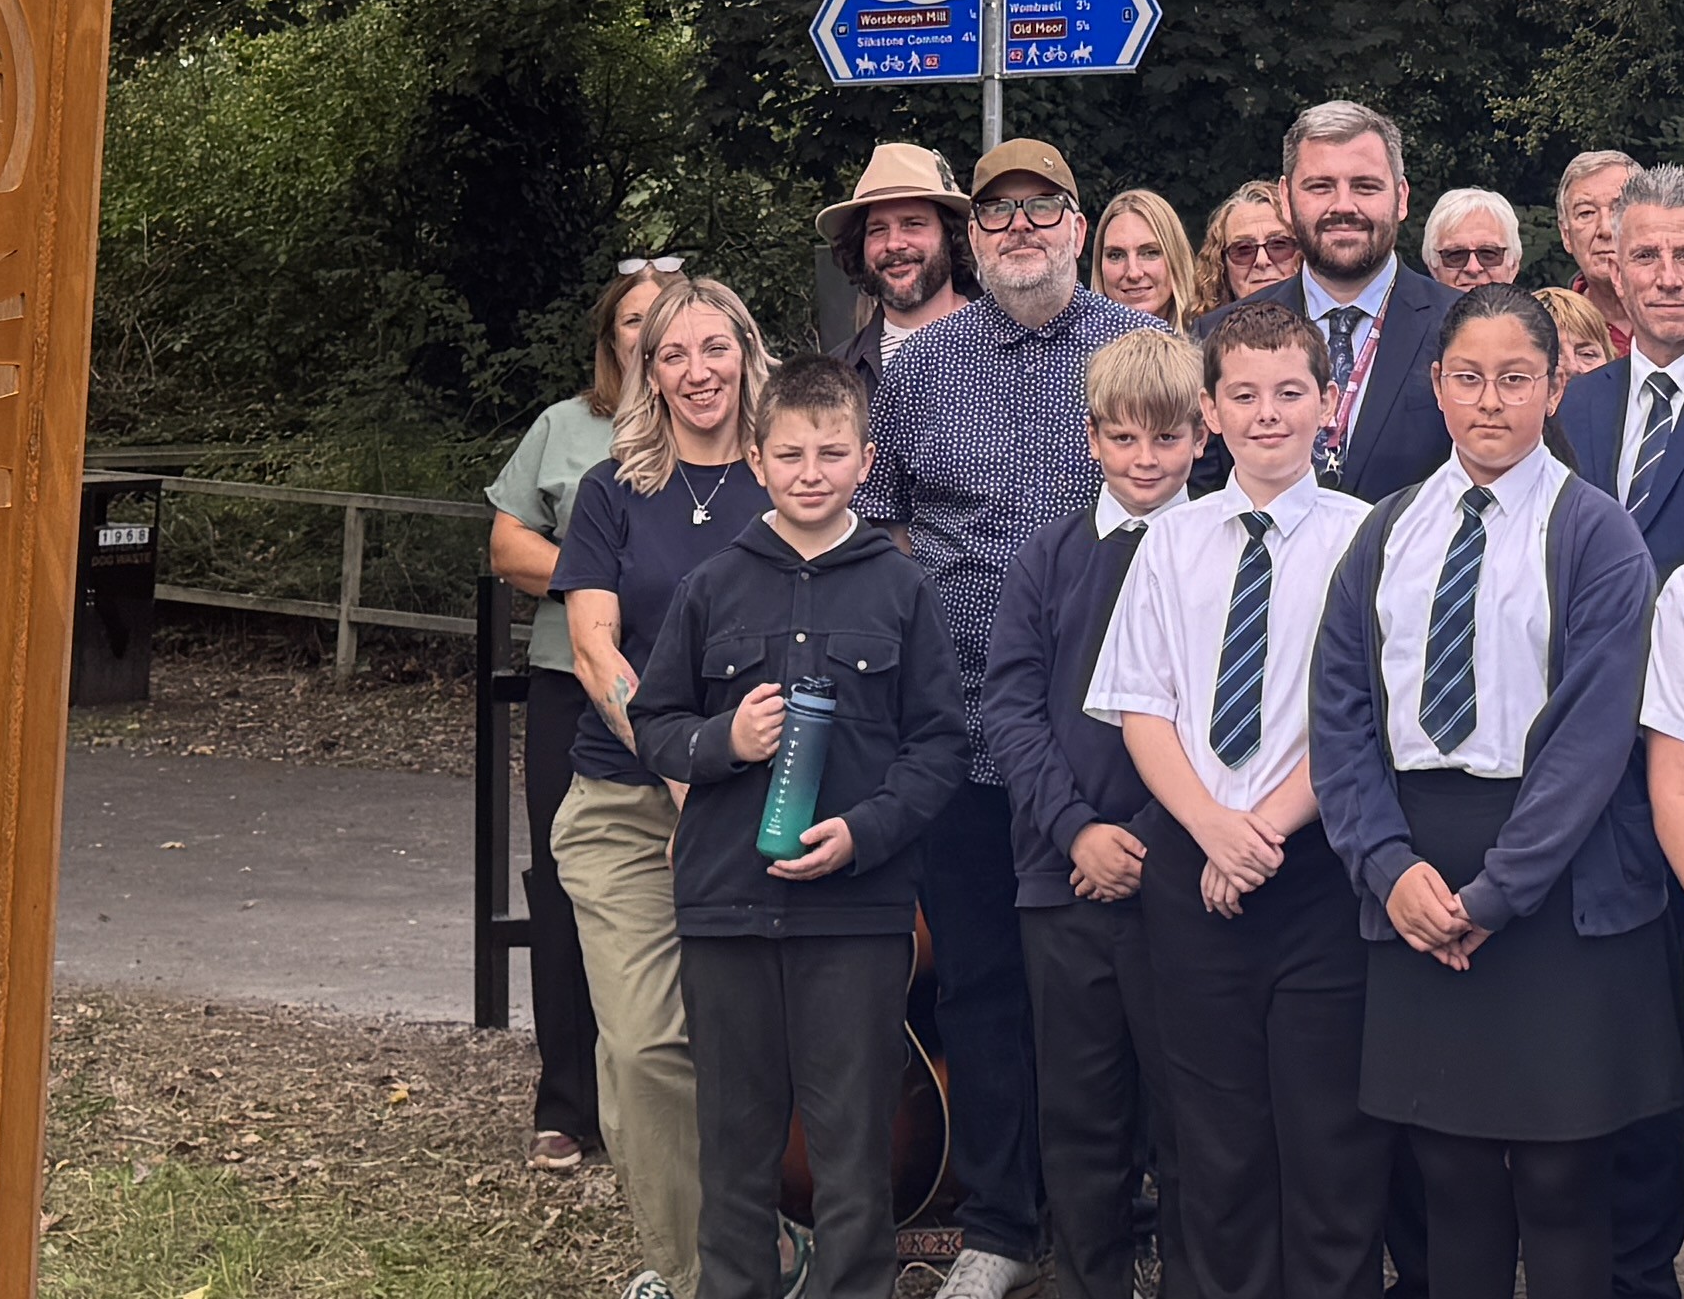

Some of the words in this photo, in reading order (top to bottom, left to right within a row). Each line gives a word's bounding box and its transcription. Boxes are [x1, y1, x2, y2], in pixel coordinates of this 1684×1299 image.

[1009, 1, 1062, 13] Wombwell
[860, 13, 923, 26] Worsbrough
[926, 11, 947, 22] Mill
[1013, 23, 1032, 35] Old
[1035, 22, 1063, 33] Moor
[857, 36, 905, 48] Silkstone
[907, 34, 953, 46] Common
[101, 529, 147, 544] 1968
